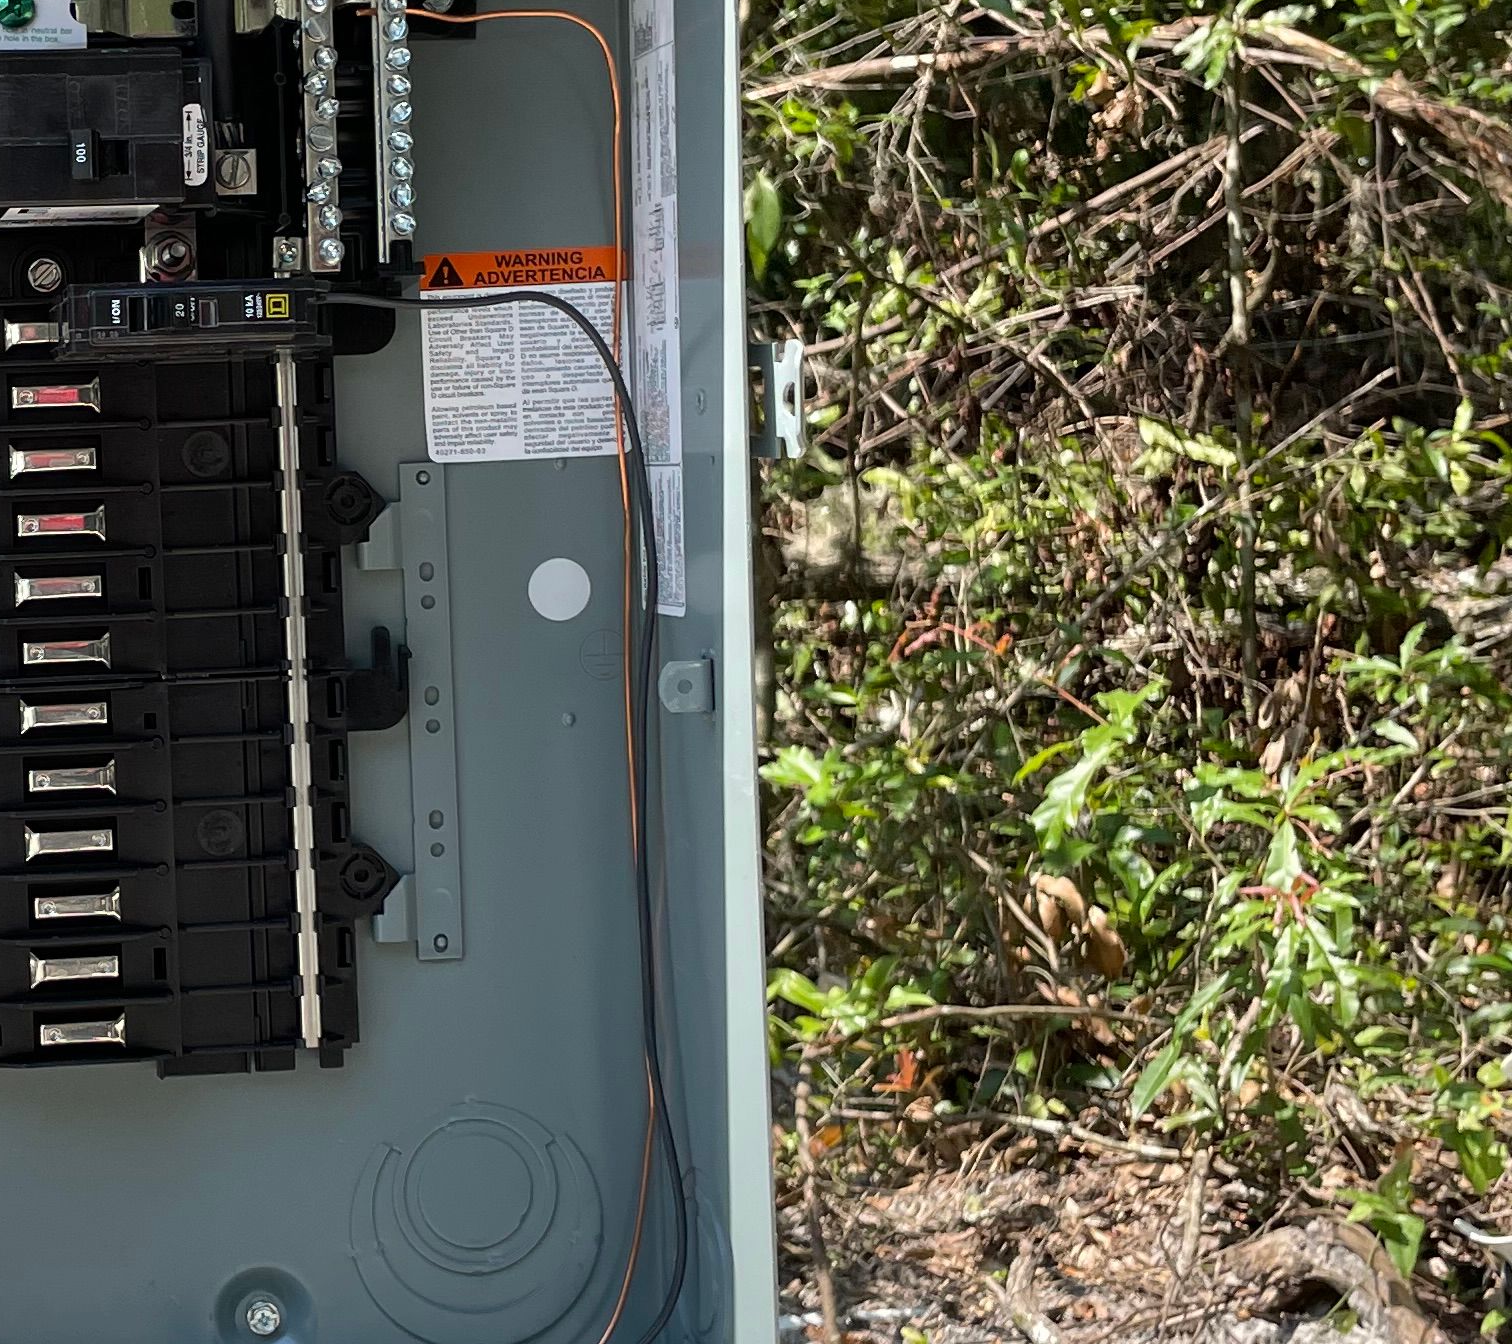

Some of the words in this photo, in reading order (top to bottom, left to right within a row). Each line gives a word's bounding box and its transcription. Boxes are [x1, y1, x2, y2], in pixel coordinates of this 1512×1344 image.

[75, 142, 87, 163] 100
[184, 145, 193, 158] 3/4
[196, 149, 205, 174] STRIP
[495, 251, 583, 268] WARNING
[473, 266, 606, 285] ADVERTENCIA
[245, 294, 254, 306] kA
[174, 303, 185, 318] 20
[245, 307, 254, 318] 10
